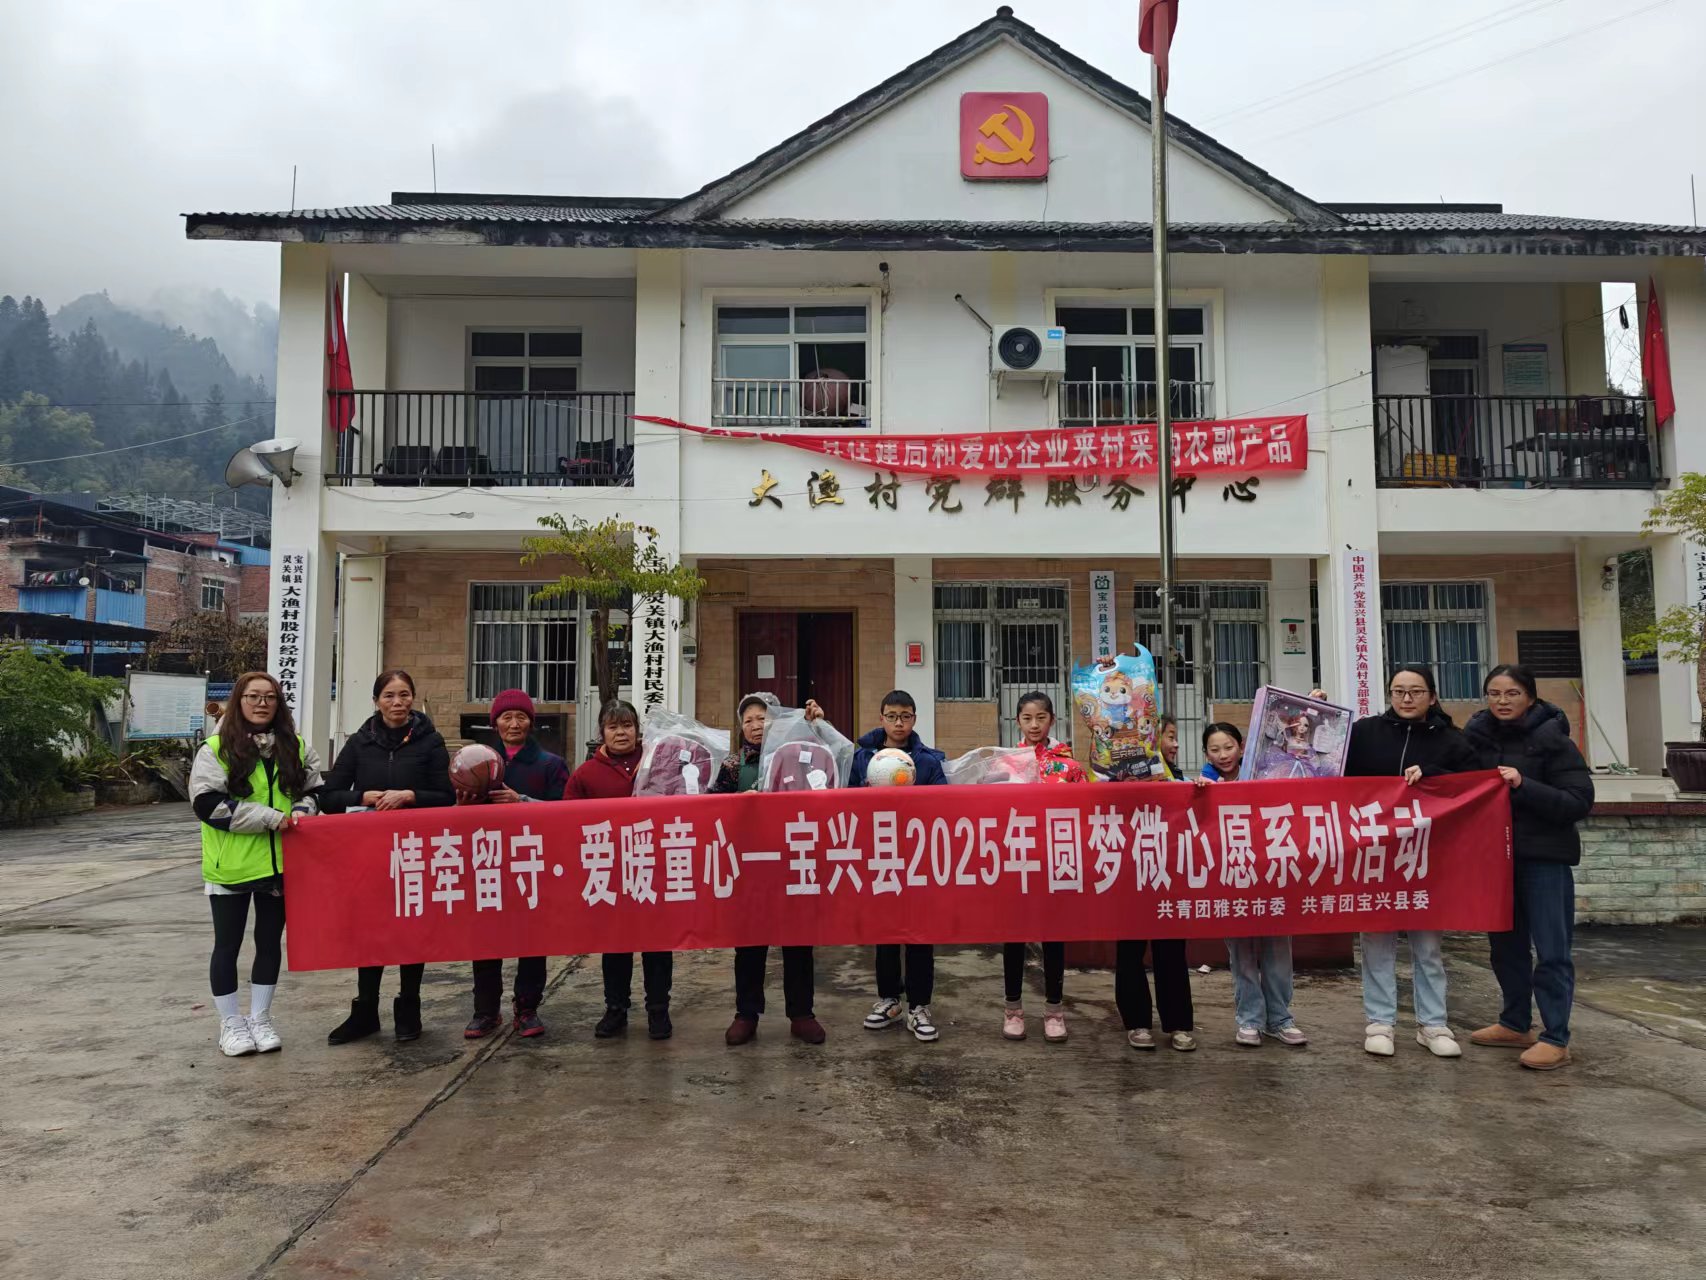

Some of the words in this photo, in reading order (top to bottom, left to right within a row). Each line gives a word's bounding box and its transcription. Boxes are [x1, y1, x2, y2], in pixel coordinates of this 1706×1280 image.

[278, 586, 301, 711] 大渔村股份经济合作联
[644, 556, 666, 717] 宝灵关镇大渔村村民委
[1352, 555, 1370, 719] 中国共产党宝兴县灵关镇大渔村支部委员
[1157, 896, 1286, 919] 共青团雅安市委
[1301, 889, 1430, 915] 共青团宝兴县委
